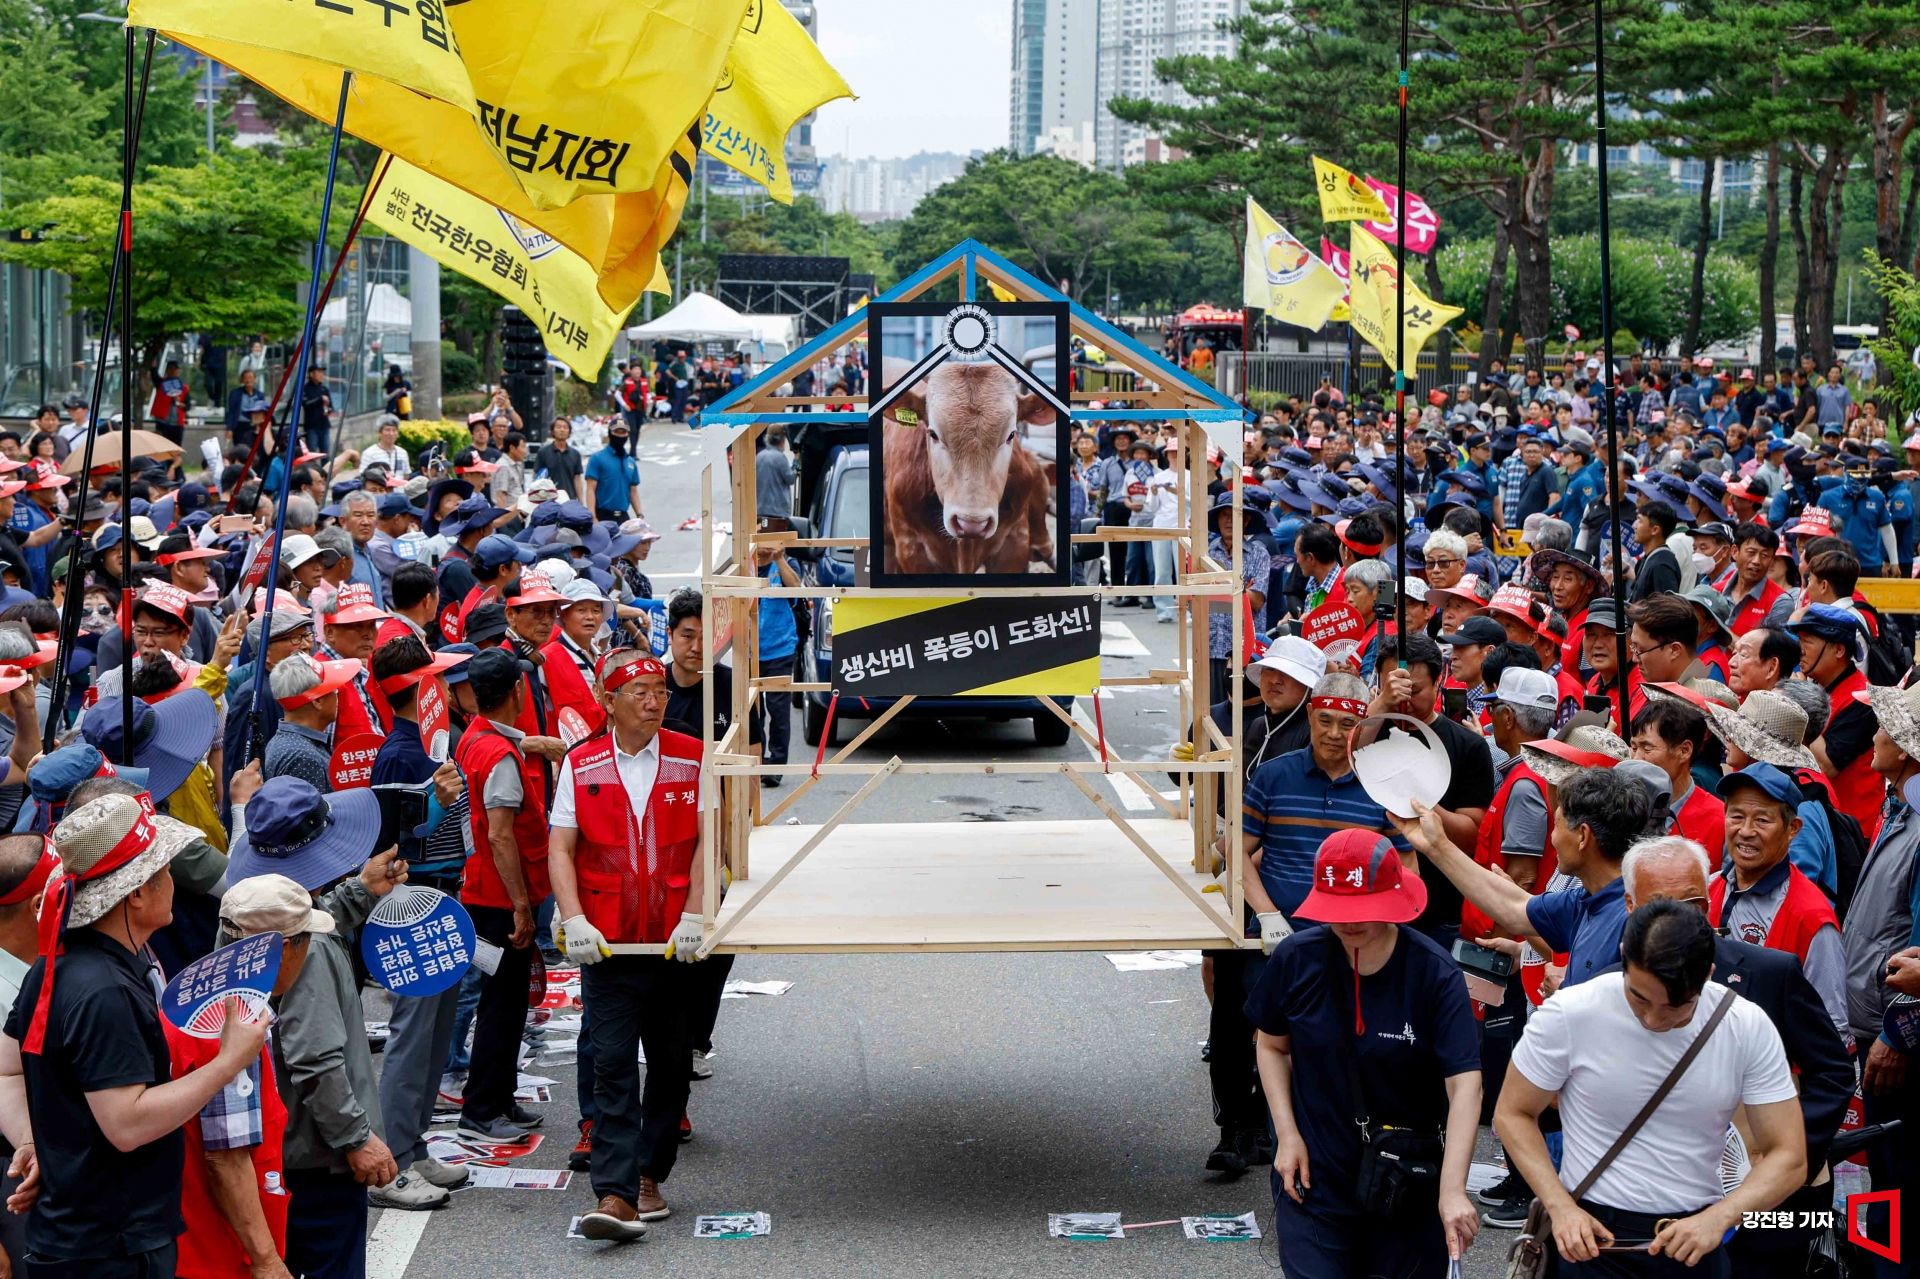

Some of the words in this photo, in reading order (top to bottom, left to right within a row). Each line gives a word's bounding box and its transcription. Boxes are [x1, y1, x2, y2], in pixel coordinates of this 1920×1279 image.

[1322, 172, 1338, 191] 상
[390, 186, 410, 207] 사단
[385, 201, 407, 222] 법인
[411, 202, 528, 291] 전국한우협회
[1311, 607, 1349, 629] 한우반납
[1307, 626, 1336, 643] 생존권
[1337, 618, 1358, 632] 쟁취
[840, 644, 915, 683] 생산비
[923, 625, 999, 662] 폭등이
[1008, 605, 1092, 645] 도화선!
[625, 664, 641, 677] 투
[420, 683, 438, 713] 한우반납
[433, 698, 444, 719] 쟁취
[341, 748, 379, 765] 한우반
[664, 791, 676, 806] 투
[681, 789, 695, 805] 쟁
[135, 823, 150, 842] 투
[46, 843, 59, 861] 투
[1321, 865, 1336, 887] 투
[1345, 866, 1363, 888] 쟁
[410, 914, 457, 942] 용산은
[376, 934, 407, 955] 거부
[416, 932, 464, 957] 정부는
[179, 962, 230, 989] 정부는
[236, 944, 271, 966] 방관
[381, 949, 414, 972] 방관
[422, 948, 469, 977] 농협은
[177, 974, 227, 1006] 용산은
[234, 957, 267, 980] 거부
[387, 966, 419, 989] 외면
[1402, 1021, 1416, 1046] 한우
